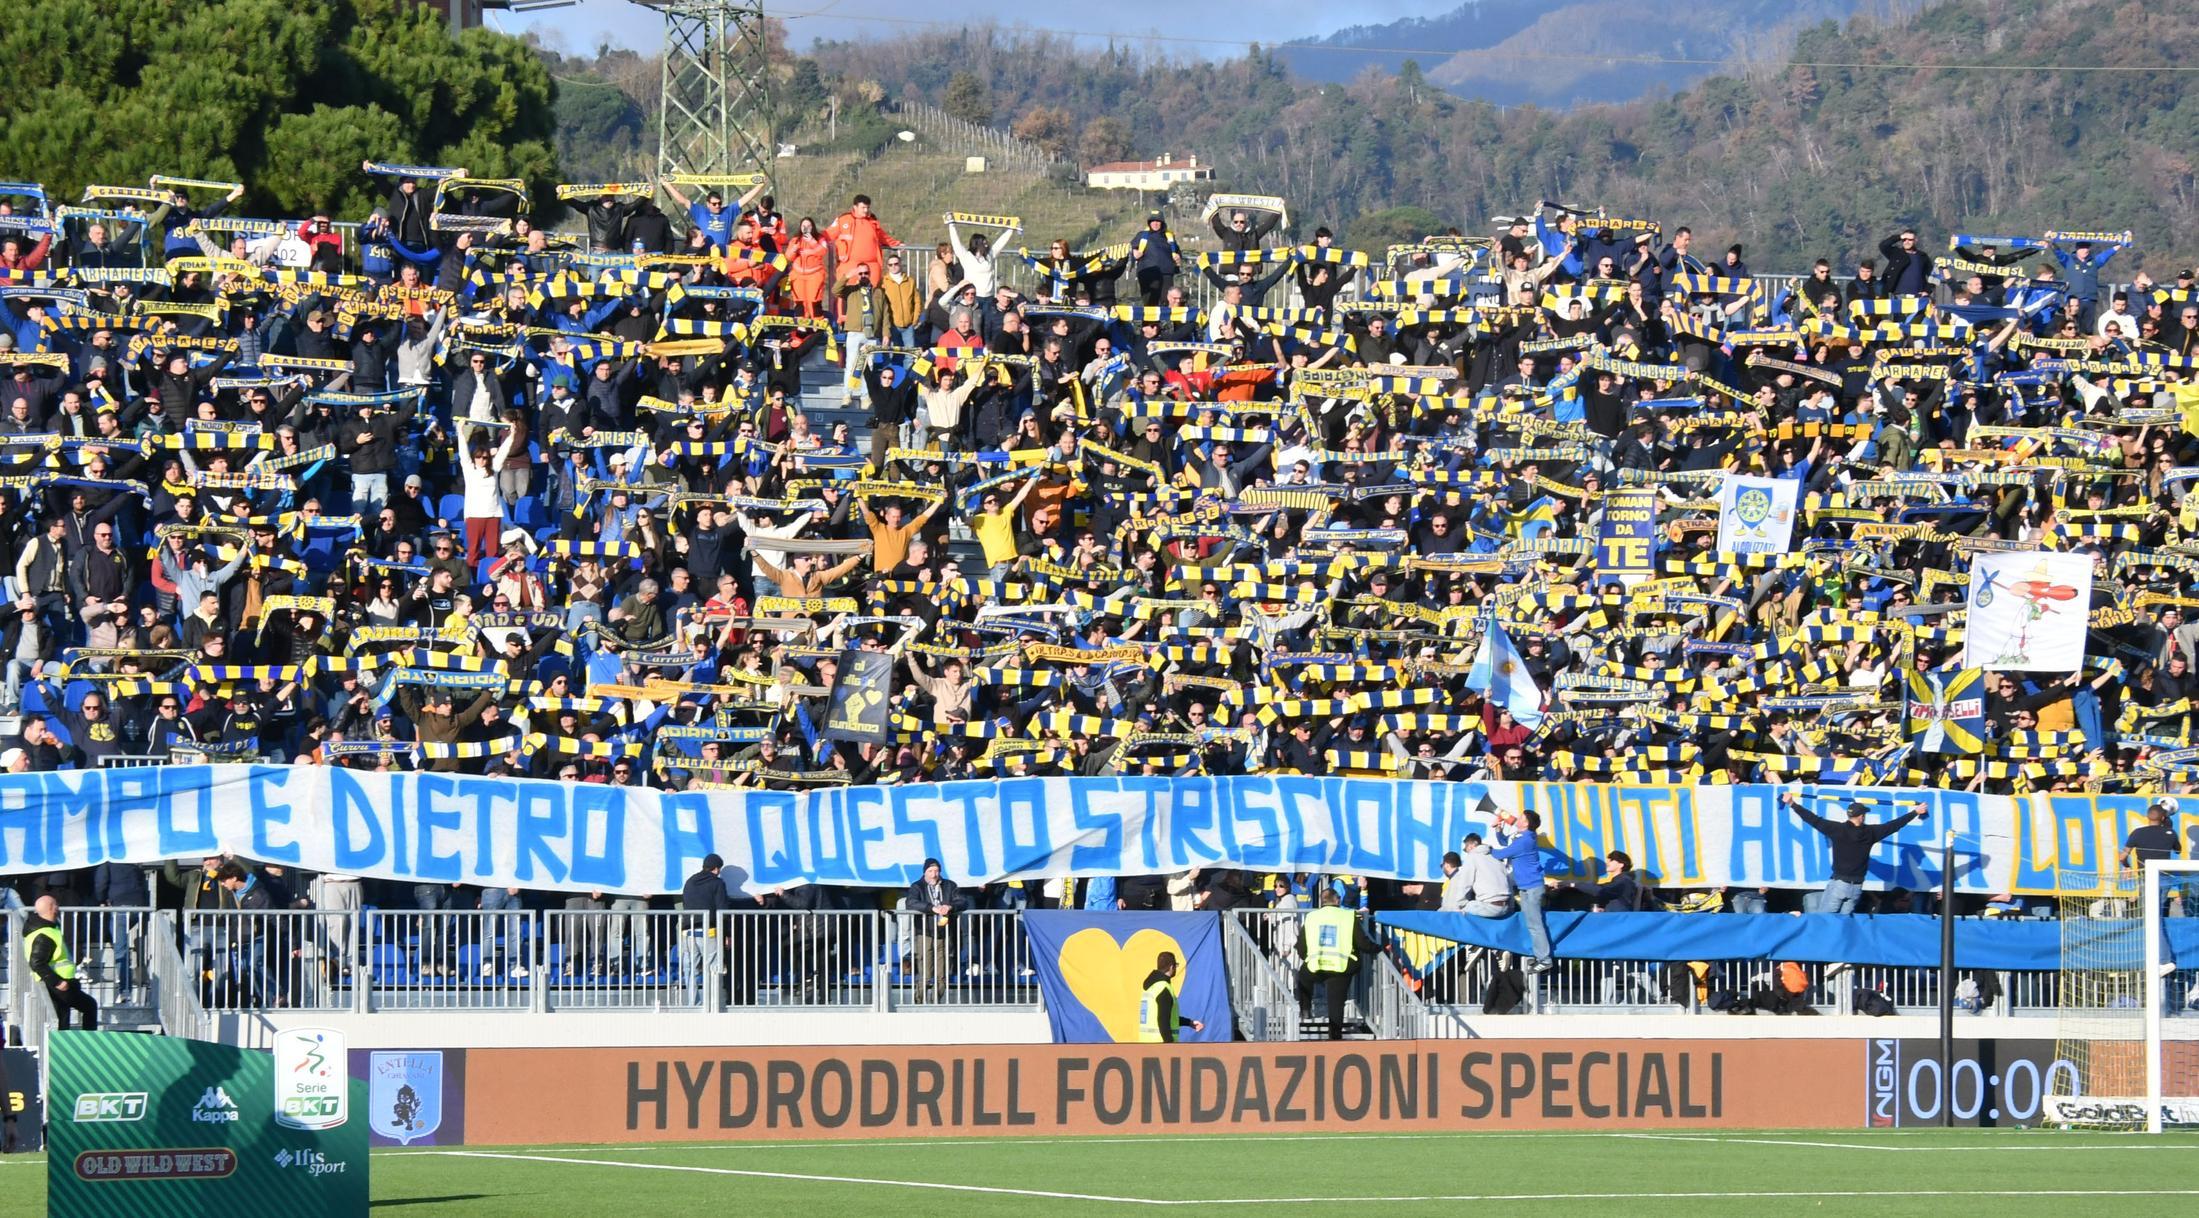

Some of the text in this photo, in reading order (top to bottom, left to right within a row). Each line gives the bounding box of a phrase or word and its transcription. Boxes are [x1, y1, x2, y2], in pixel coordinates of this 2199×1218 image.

[960, 214, 1011, 226] CARRARA
[222, 262, 248, 272] TRIP
[273, 356, 337, 368] CARRARA
[1606, 496, 1653, 508] DOMANI
[1606, 510, 1650, 522] TORNO
[1615, 525, 1635, 536] DA
[1602, 537, 1650, 568] TE
[175, 736, 249, 753] SCHIAVI DI
[0, 767, 219, 867] AMPO
[249, 767, 301, 862] E
[330, 765, 626, 888] DIETRO
[659, 791, 717, 892] A
[744, 778, 1053, 885] QUESTO
[1729, 783, 1989, 889] ANORA
[296, 1082, 328, 1094] Serie
[626, 1050, 1723, 1130] HYDRODRILL FONDAZIONI SPECIALI
[1907, 1058, 2081, 1120] 00:00
[77, 1096, 145, 1118] BKT
[284, 1096, 339, 1116] BKT
[2056, 1102, 2180, 1122] GoldBt
[192, 1108, 239, 1124] Kappa
[82, 1152, 229, 1175] OLD WILD WEST
[294, 1148, 325, 1167] Ifis
[308, 1160, 347, 1177] sport
